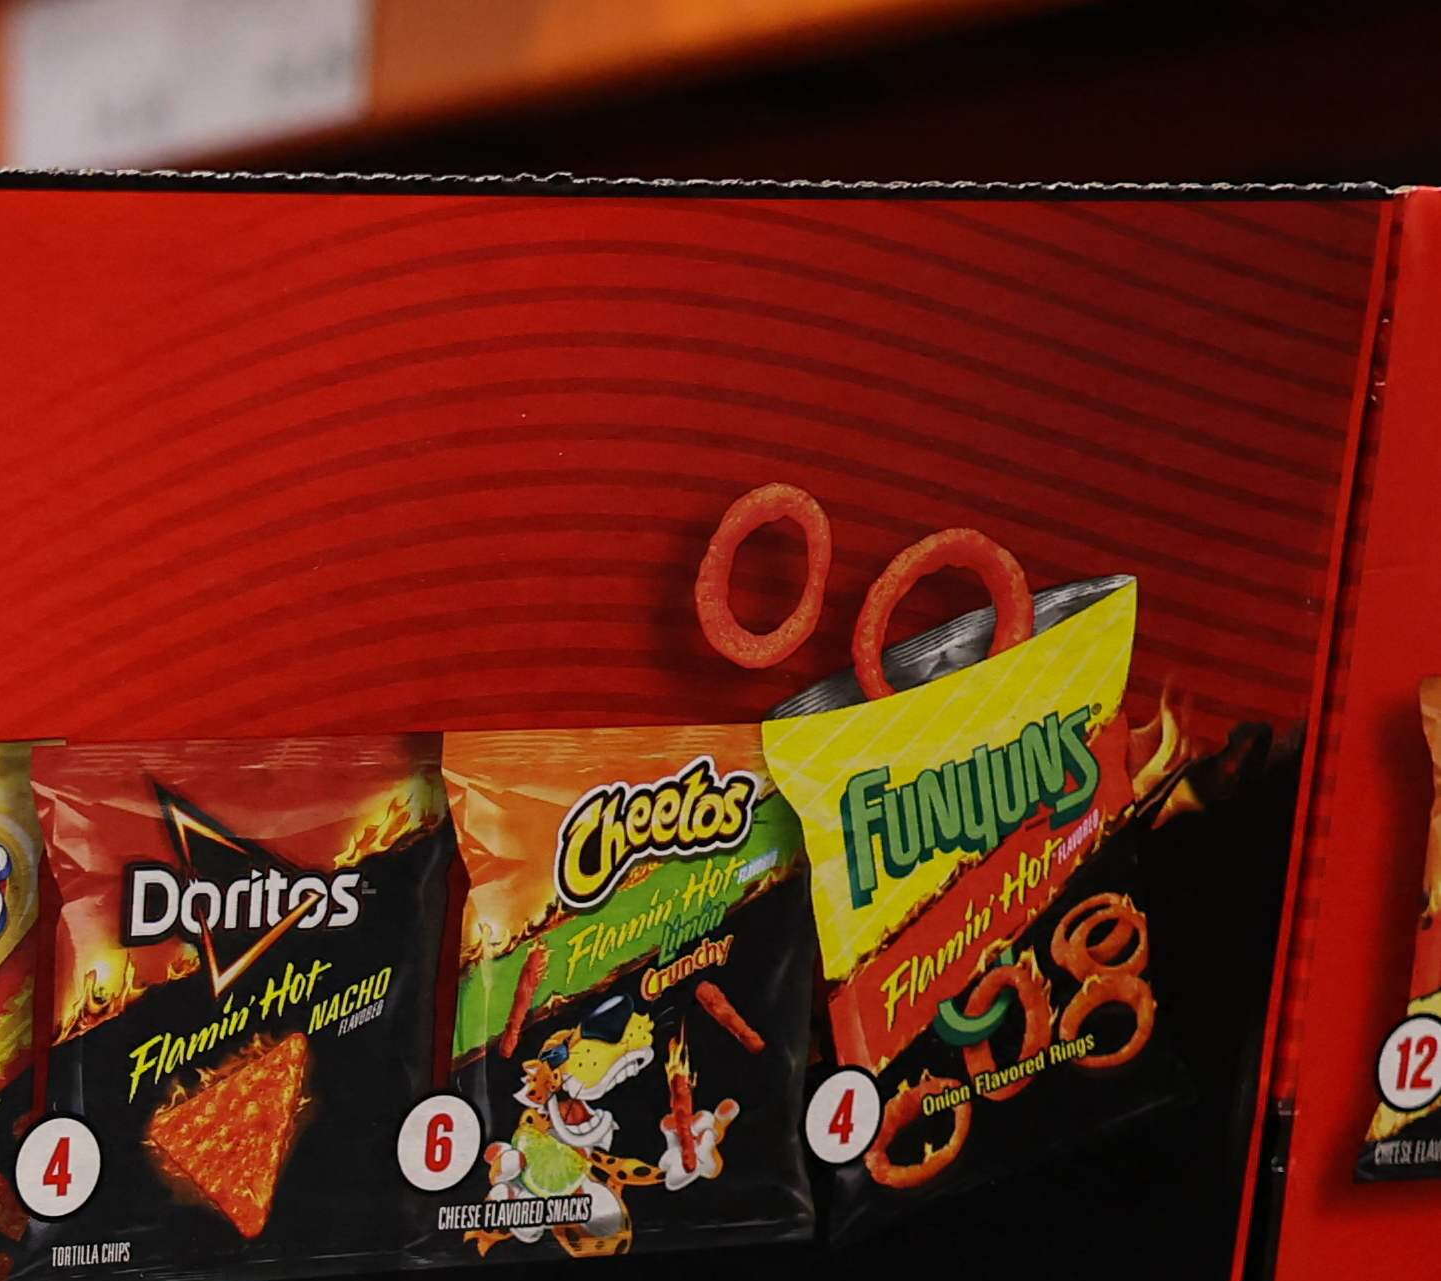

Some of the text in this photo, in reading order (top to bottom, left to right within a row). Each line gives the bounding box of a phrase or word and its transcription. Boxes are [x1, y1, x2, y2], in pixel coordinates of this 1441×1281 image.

[555, 754, 756, 909] Cheetos
[130, 867, 361, 938] Doritos
[566, 856, 744, 986] Flamin' Hot
[658, 902, 727, 966] Limón
[880, 810, 1101, 1033] Flamin' Hot FLAVORED
[641, 933, 736, 1001] Crunchy
[128, 959, 332, 1104] Flamin' Hot
[308, 965, 392, 1036] NACHO
[337, 999, 384, 1038] FLAVORED
[922, 1031, 1096, 1117] Onion Flavored Rings
[1396, 1035, 1437, 1091] 12
[425, 1113, 453, 1173] 6
[828, 1088, 856, 1145] 4
[42, 1136, 72, 1197] 4
[438, 1195, 592, 1231] CHEESE FLAVORED SNACKS
[51, 1240, 131, 1268] TORTILLA CHIPS
